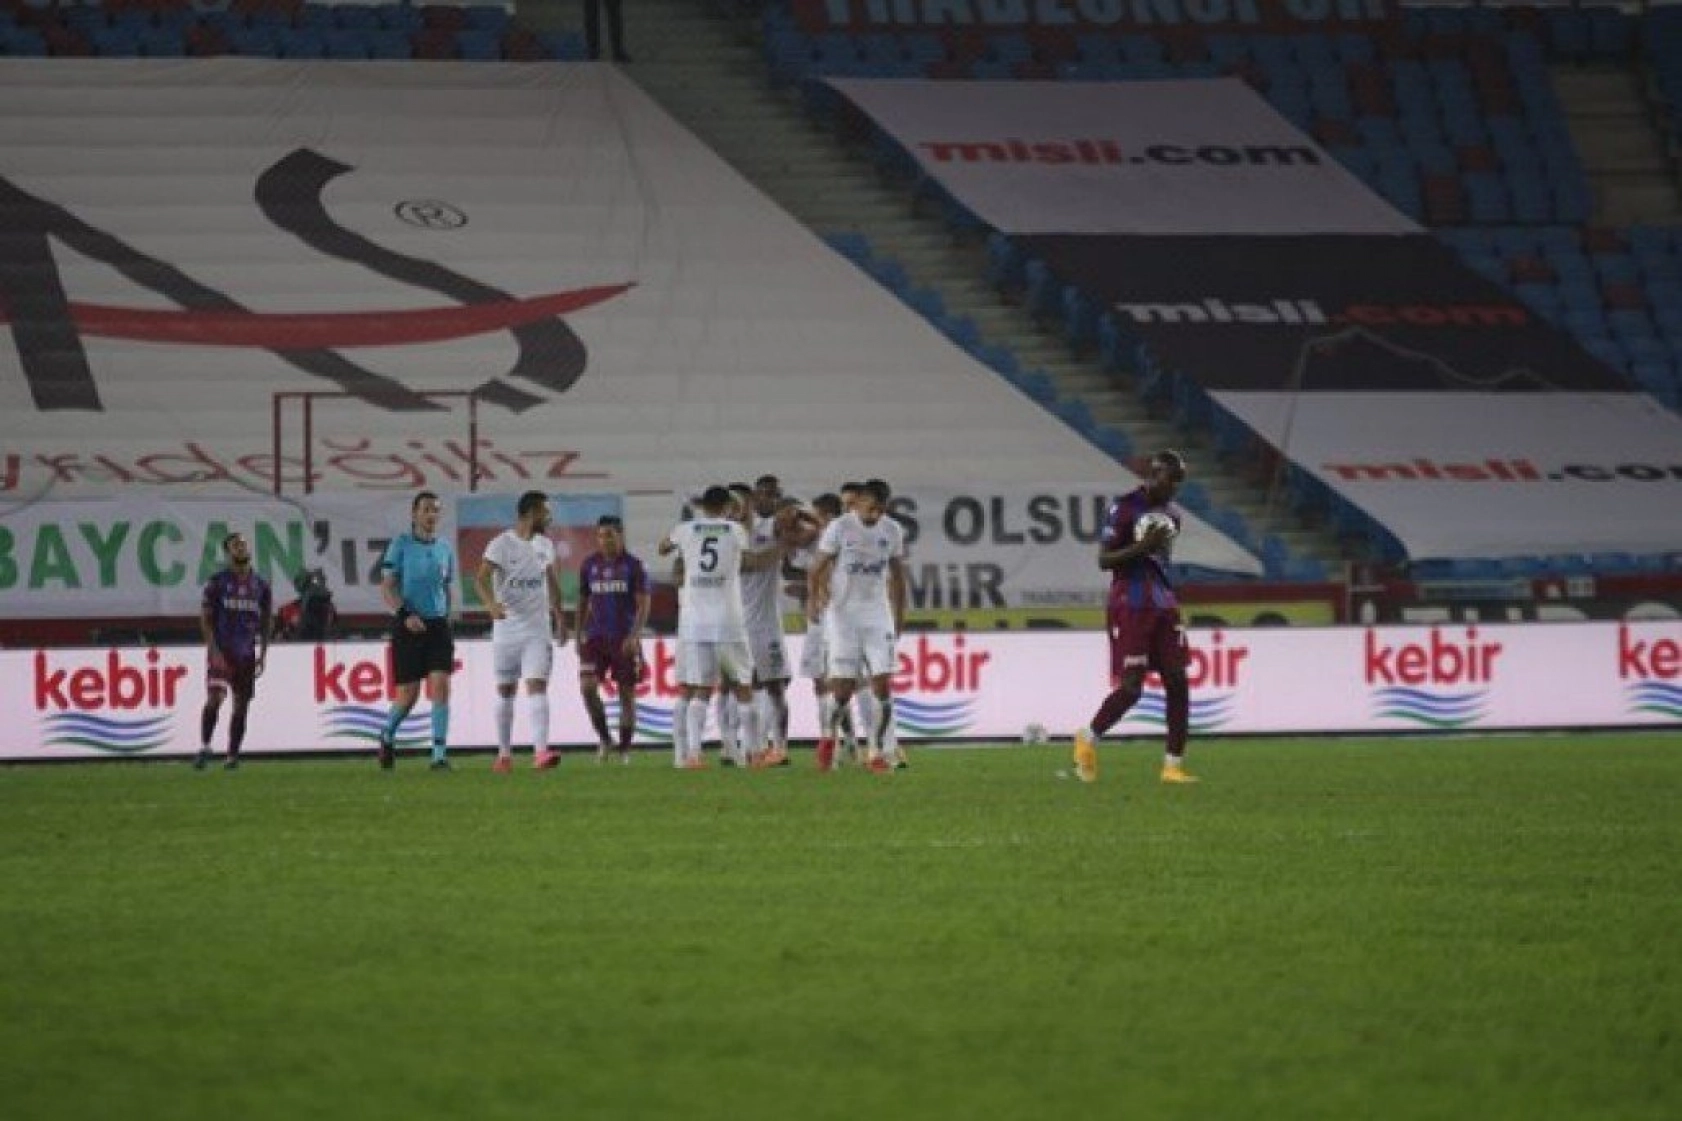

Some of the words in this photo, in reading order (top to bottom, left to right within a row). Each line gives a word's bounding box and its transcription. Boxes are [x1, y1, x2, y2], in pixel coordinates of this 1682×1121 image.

[921, 138, 1321, 166] misli.com
[1114, 298, 1527, 326] misli.com
[1322, 457, 1682, 482] misli.co
[943, 494, 1105, 546] OLSU
[699, 536, 719, 573] 5
[889, 631, 990, 693] ebir
[1365, 622, 1503, 684] kebir
[35, 645, 188, 710] kebir
